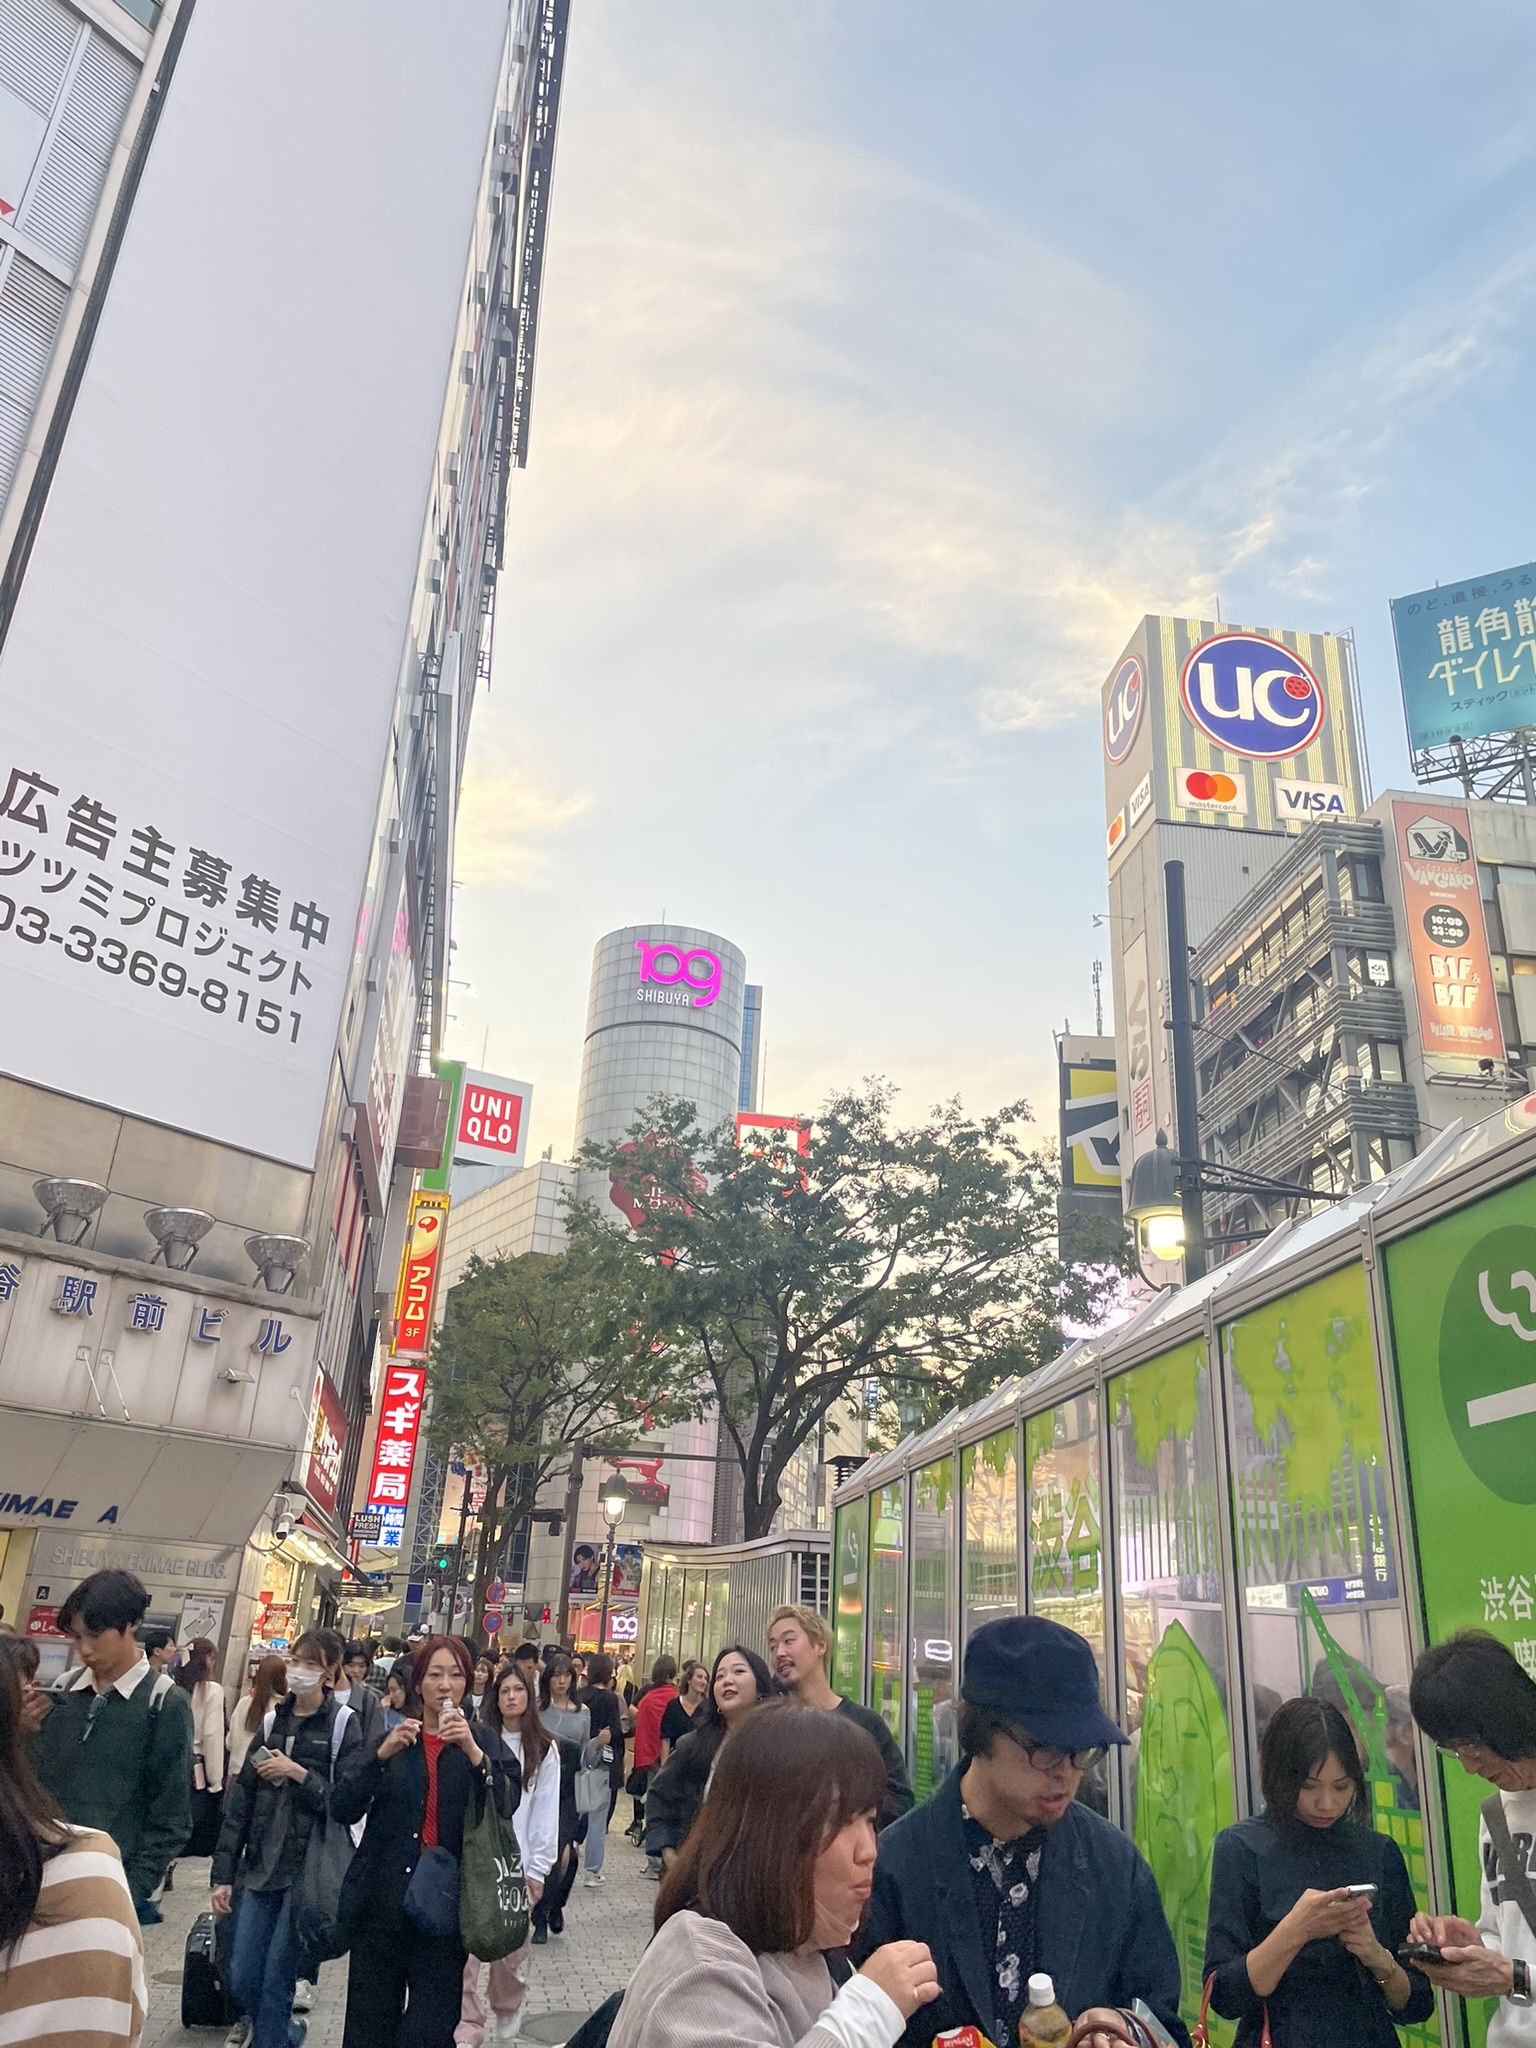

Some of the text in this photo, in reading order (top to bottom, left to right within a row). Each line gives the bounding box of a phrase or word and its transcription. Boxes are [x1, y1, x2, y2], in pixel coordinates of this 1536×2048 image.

[1451, 690, 1508, 713] スティック
[1130, 782, 1150, 815] VISA
[1188, 800, 1237, 812] mastercard
[1278, 787, 1345, 814] VISA
[0, 767, 330, 951] 広告主募集中
[0, 840, 313, 996] ツツミプロジェクト
[1431, 909, 1463, 927] 10:00
[1431, 925, 1465, 939] 23:00
[635, 939, 723, 1008] 109
[1429, 954, 1473, 981] B1F
[636, 988, 690, 1007] SHIBUYA
[1432, 981, 1479, 1009] B2F
[469, 1091, 511, 1121] UNI
[465, 1116, 513, 1146] QLO
[405, 1265, 432, 1321] アコム
[405, 1328, 420, 1337] 3F
[372, 1371, 420, 1501] スギ薬局
[0, 1492, 119, 1524] IMAE A
[355, 1514, 381, 1523] LUSH
[354, 1522, 380, 1530] FRESH
[1029, 1475, 1101, 1598] 渋谷
[51, 1545, 227, 1580] SHIBUYA EKIMAE BLDG.
[1480, 1573, 1536, 1622] 渋谷
[611, 1616, 638, 1640] 109
